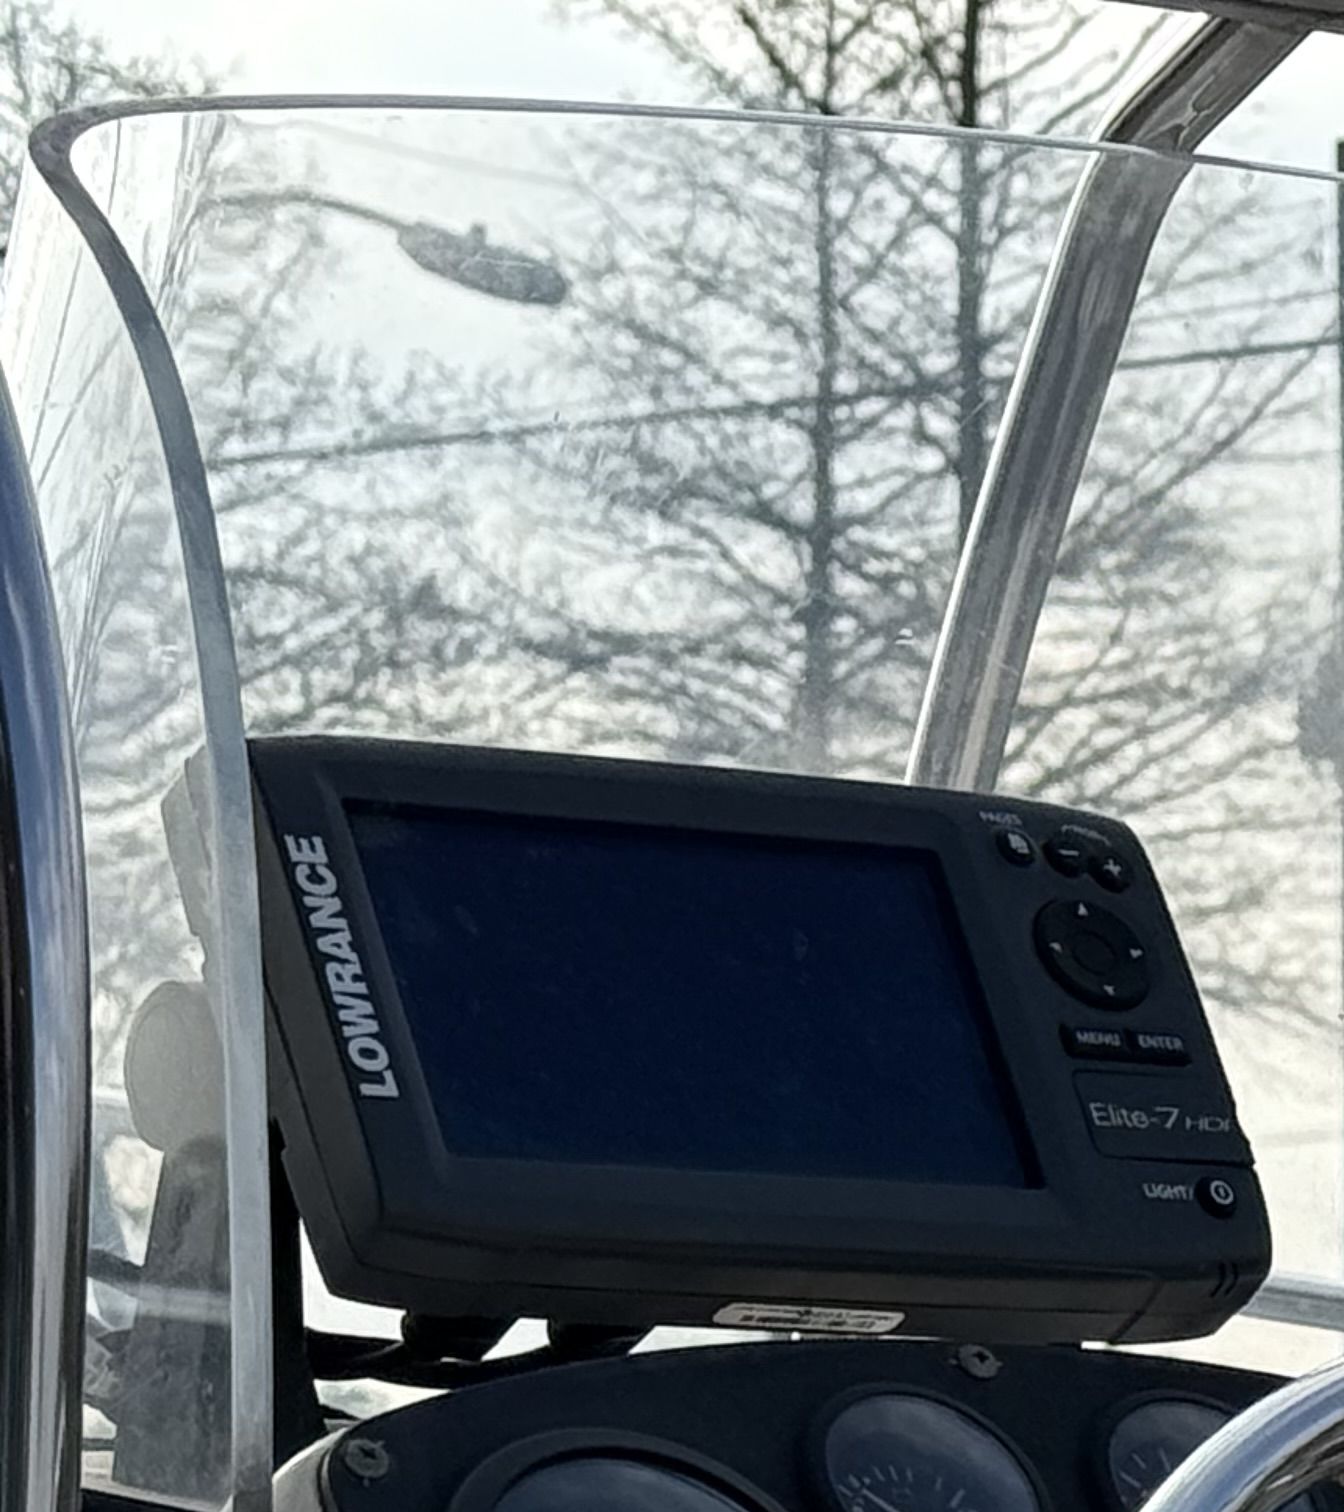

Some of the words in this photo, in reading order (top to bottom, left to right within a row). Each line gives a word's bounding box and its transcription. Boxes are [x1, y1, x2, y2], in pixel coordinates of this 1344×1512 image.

[284, 834, 399, 1098] LOWRANCE
[1076, 1030, 1121, 1048] MENU
[1137, 1033, 1184, 1051] ENTER
[1088, 1101, 1180, 1130] Elite-7
